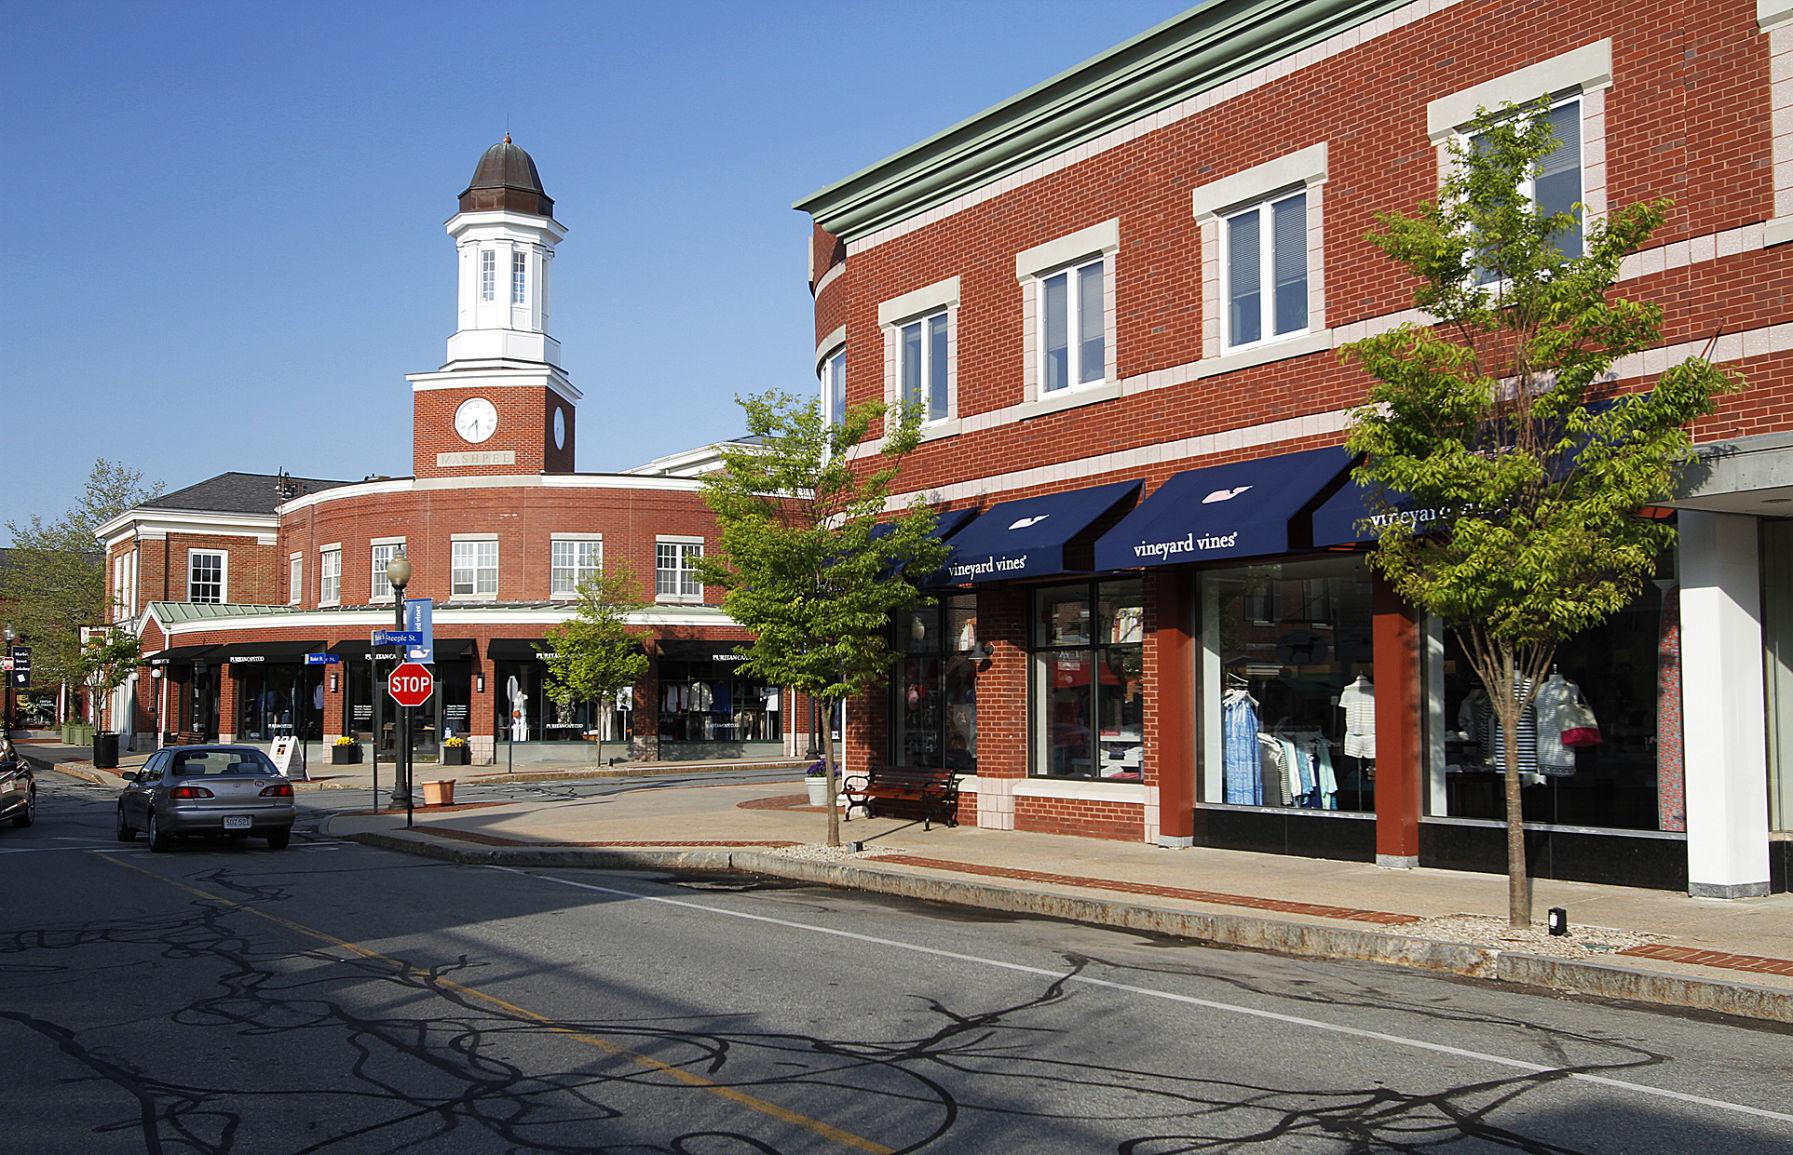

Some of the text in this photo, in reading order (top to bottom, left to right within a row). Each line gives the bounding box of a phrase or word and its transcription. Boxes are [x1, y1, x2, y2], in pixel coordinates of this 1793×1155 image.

[1133, 532, 1194, 561] vineyard
[948, 556, 994, 581] vineyard
[392, 676, 430, 693] STOP
